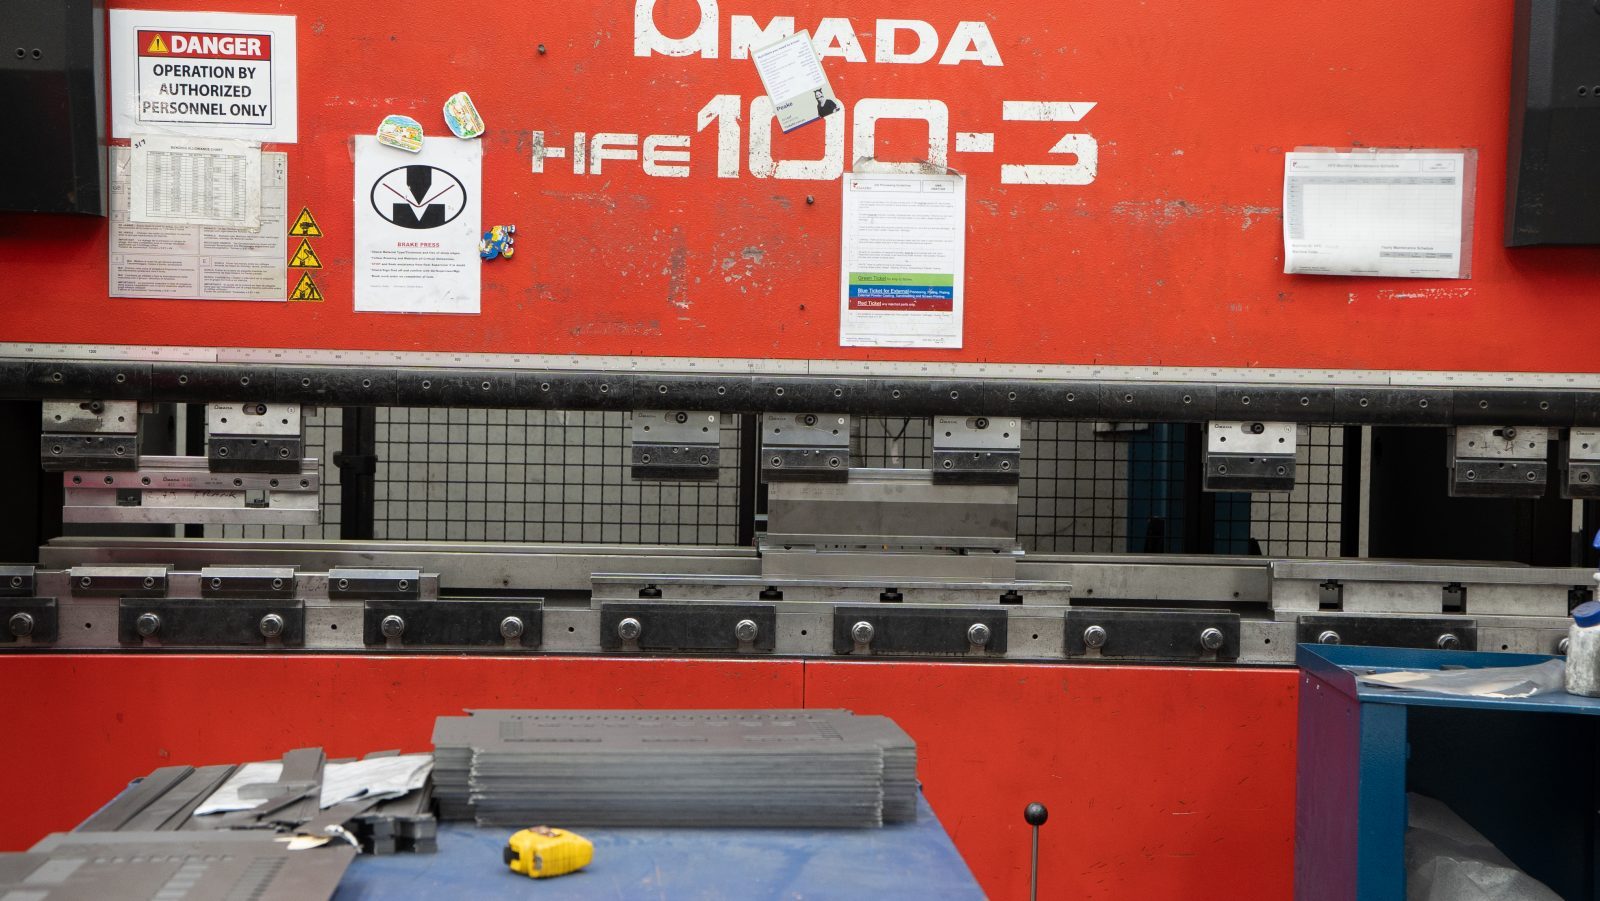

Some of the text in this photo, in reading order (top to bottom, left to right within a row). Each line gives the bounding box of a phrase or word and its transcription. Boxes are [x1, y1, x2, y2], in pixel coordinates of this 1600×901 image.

[171, 35, 262, 57] DANGER
[153, 63, 257, 80] OPERATION BY
[159, 82, 252, 98] AUTHORIZED
[142, 100, 268, 117] PERSONNEL ONLY
